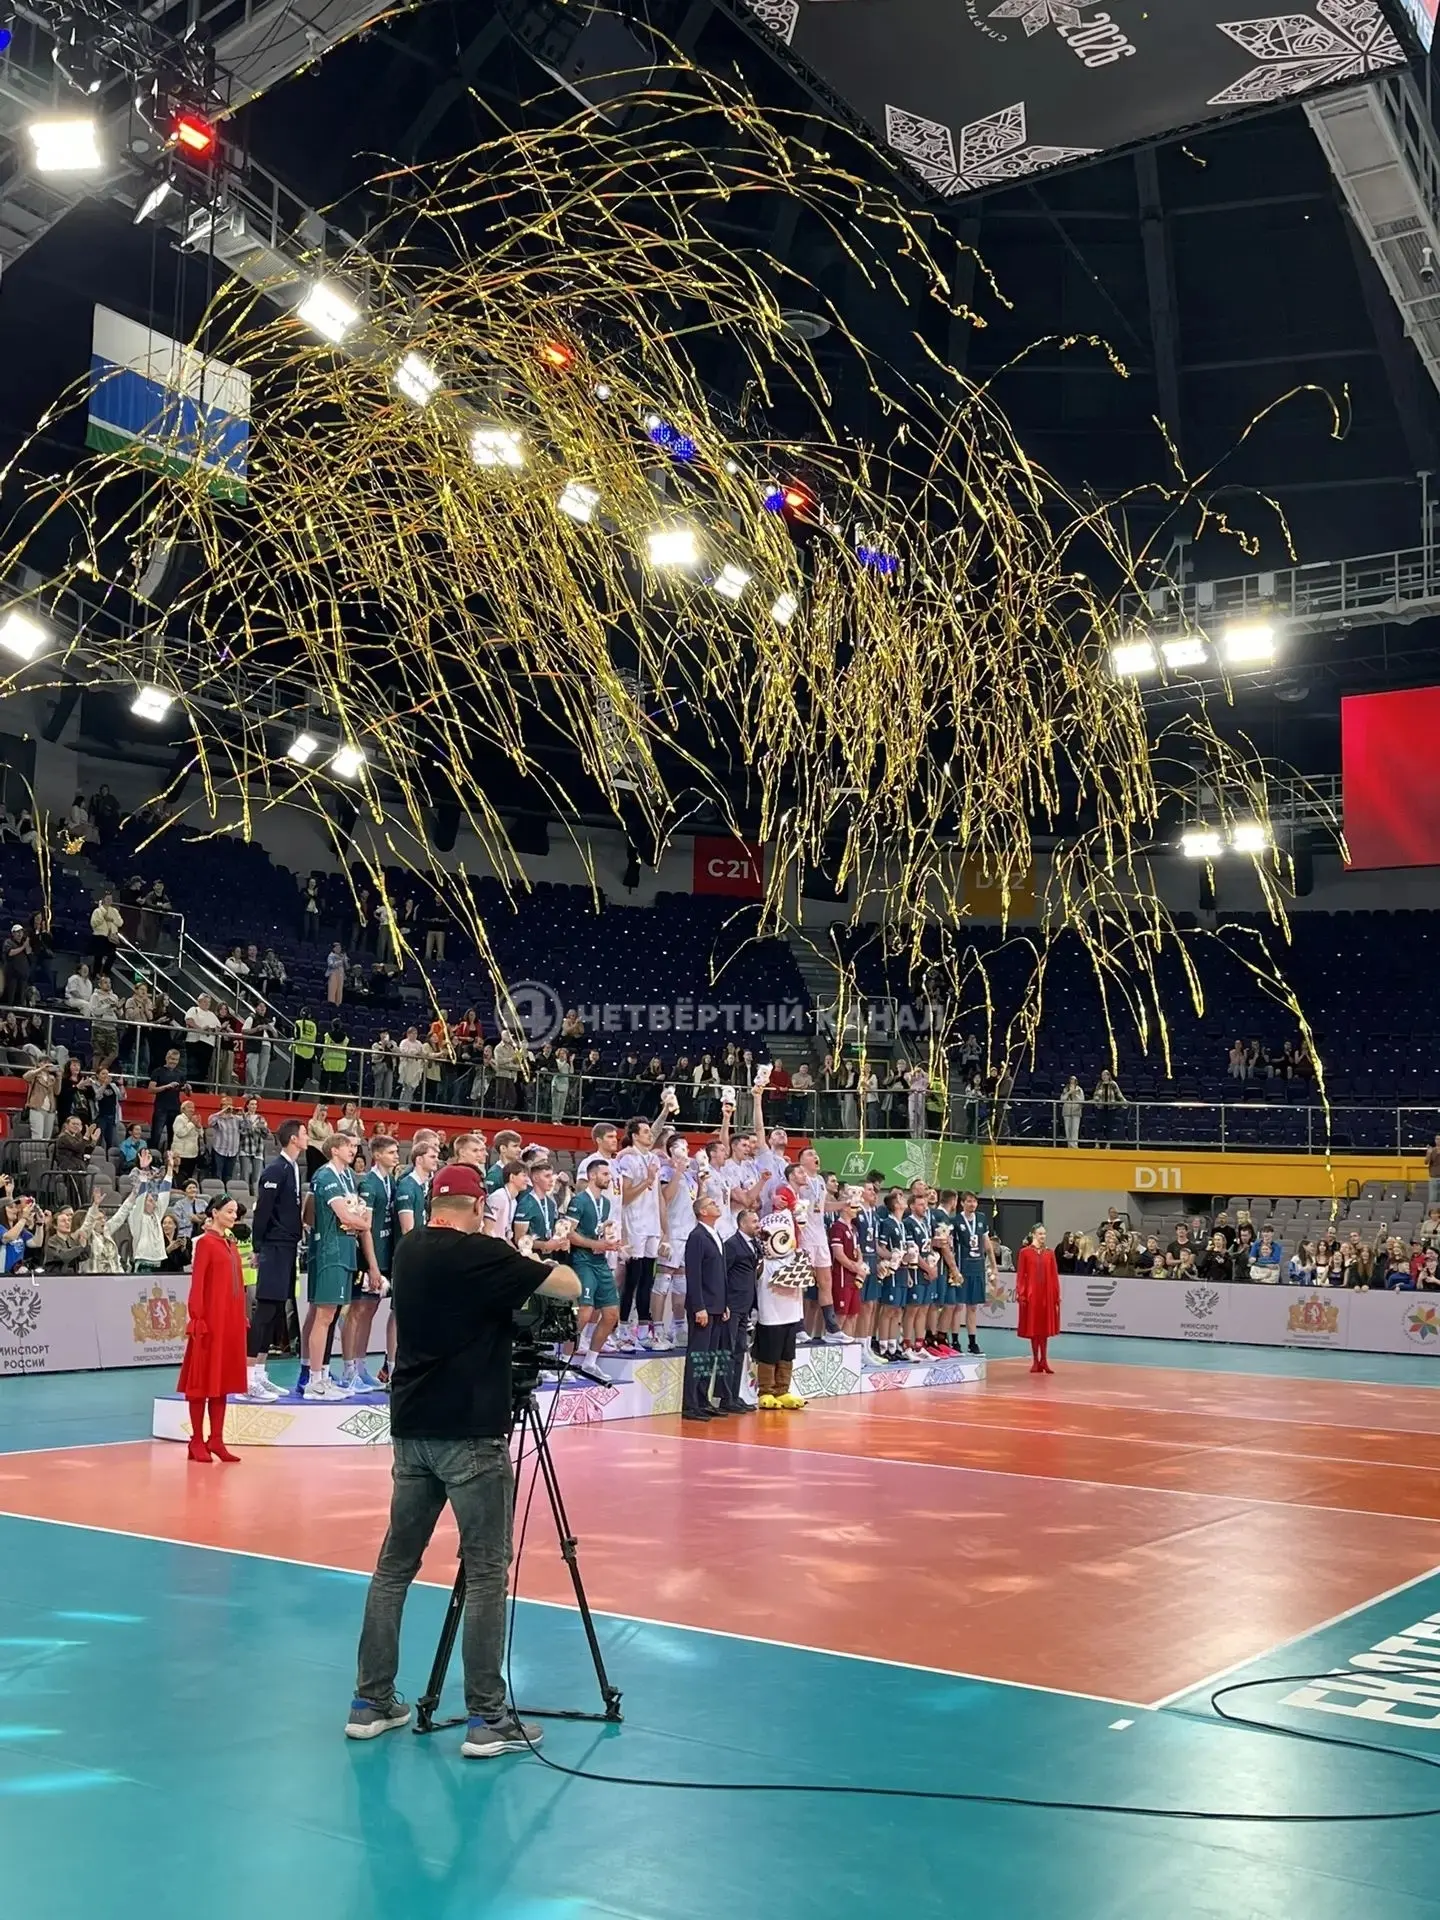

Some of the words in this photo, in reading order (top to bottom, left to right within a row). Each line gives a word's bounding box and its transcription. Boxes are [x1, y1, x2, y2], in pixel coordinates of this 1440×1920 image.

[1057, 12, 1137, 69] 2026
[707, 857, 749, 880] C21
[1134, 1167, 1182, 1190] D11
[4, 1358, 45, 1369] РОССИИ
